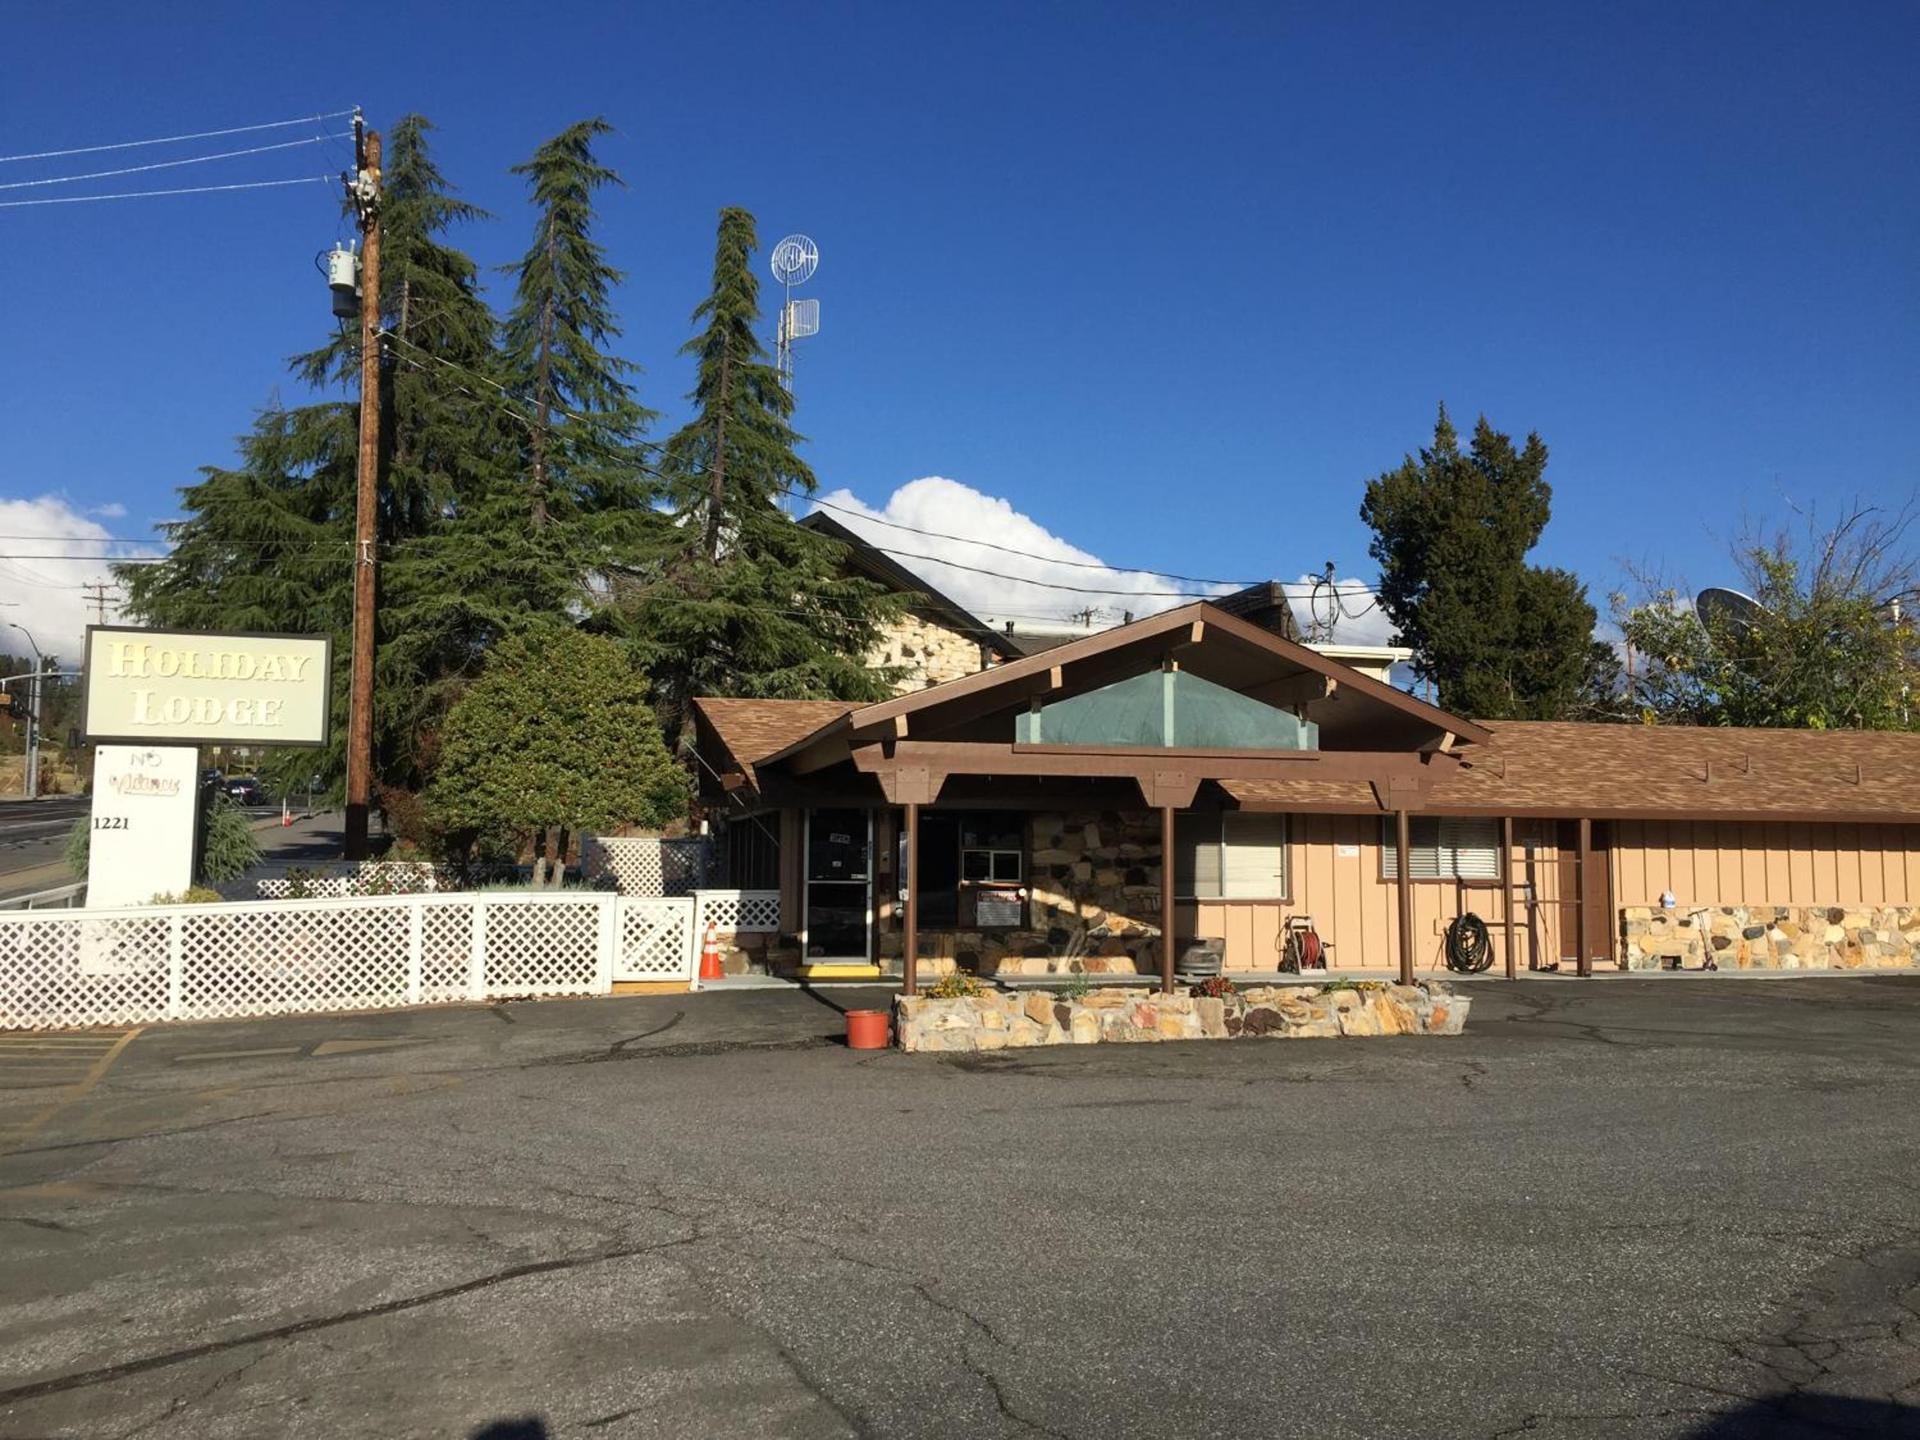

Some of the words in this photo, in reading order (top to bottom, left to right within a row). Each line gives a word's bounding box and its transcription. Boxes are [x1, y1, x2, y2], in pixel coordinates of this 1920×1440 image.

[107, 641, 311, 682] HOLIDAY
[130, 689, 286, 726] LODGE
[131, 753, 162, 767] NO
[94, 817, 129, 830] 1221
